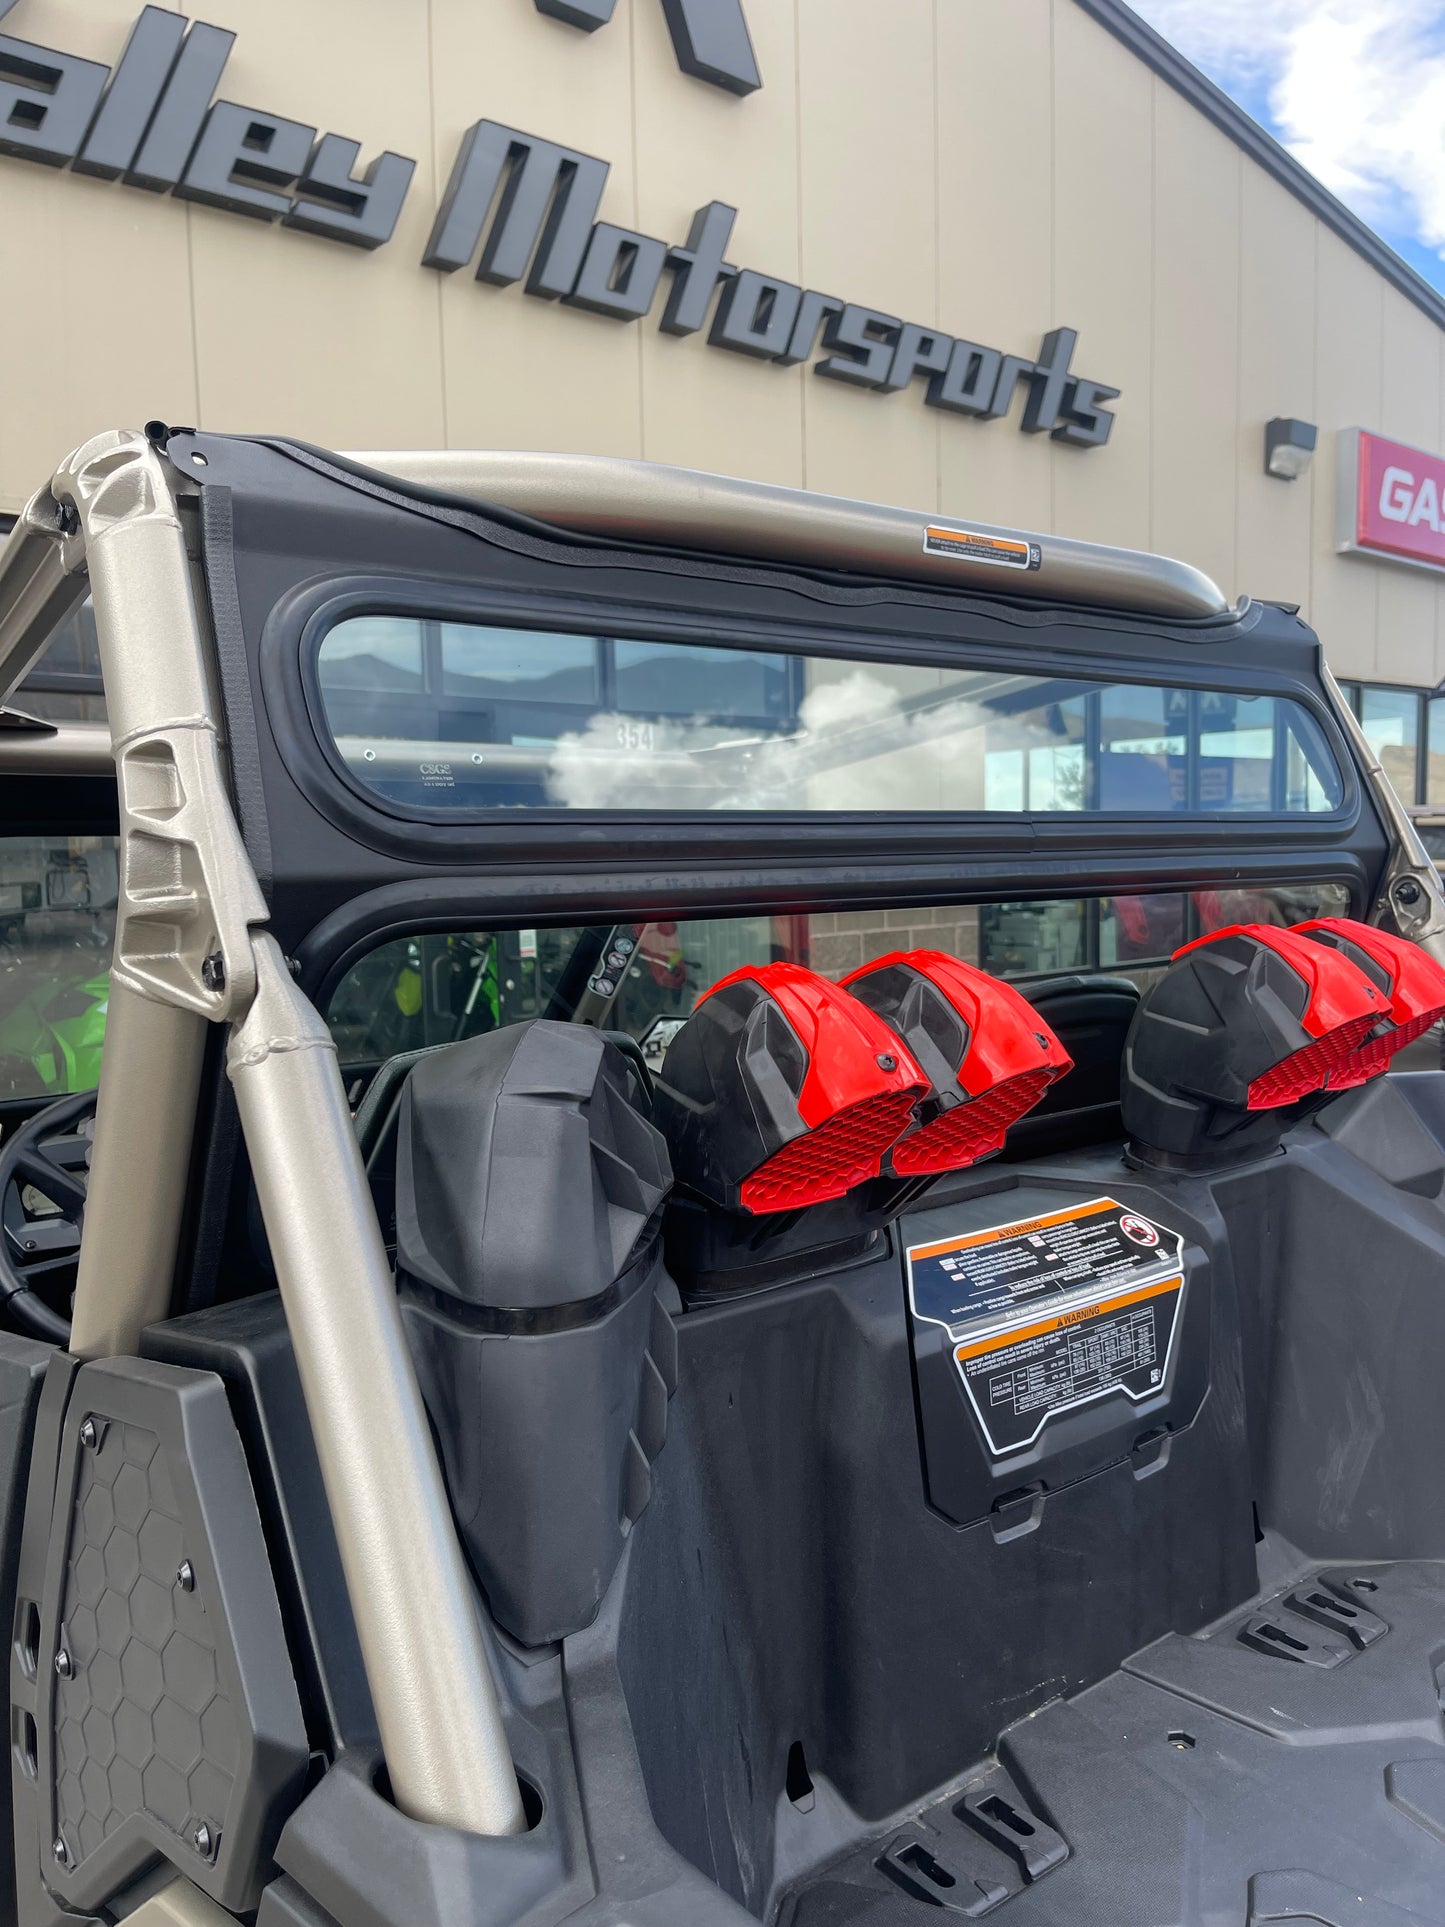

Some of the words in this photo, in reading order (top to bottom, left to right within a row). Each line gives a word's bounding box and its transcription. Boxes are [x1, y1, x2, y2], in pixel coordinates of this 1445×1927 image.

[0, 0, 417, 251] alley
[421, 119, 1121, 448] Motorsports
[1379, 466, 1445, 535] GA
[1004, 1221, 1042, 1236] WARNING
[1064, 1306, 1100, 1325] WARNING
